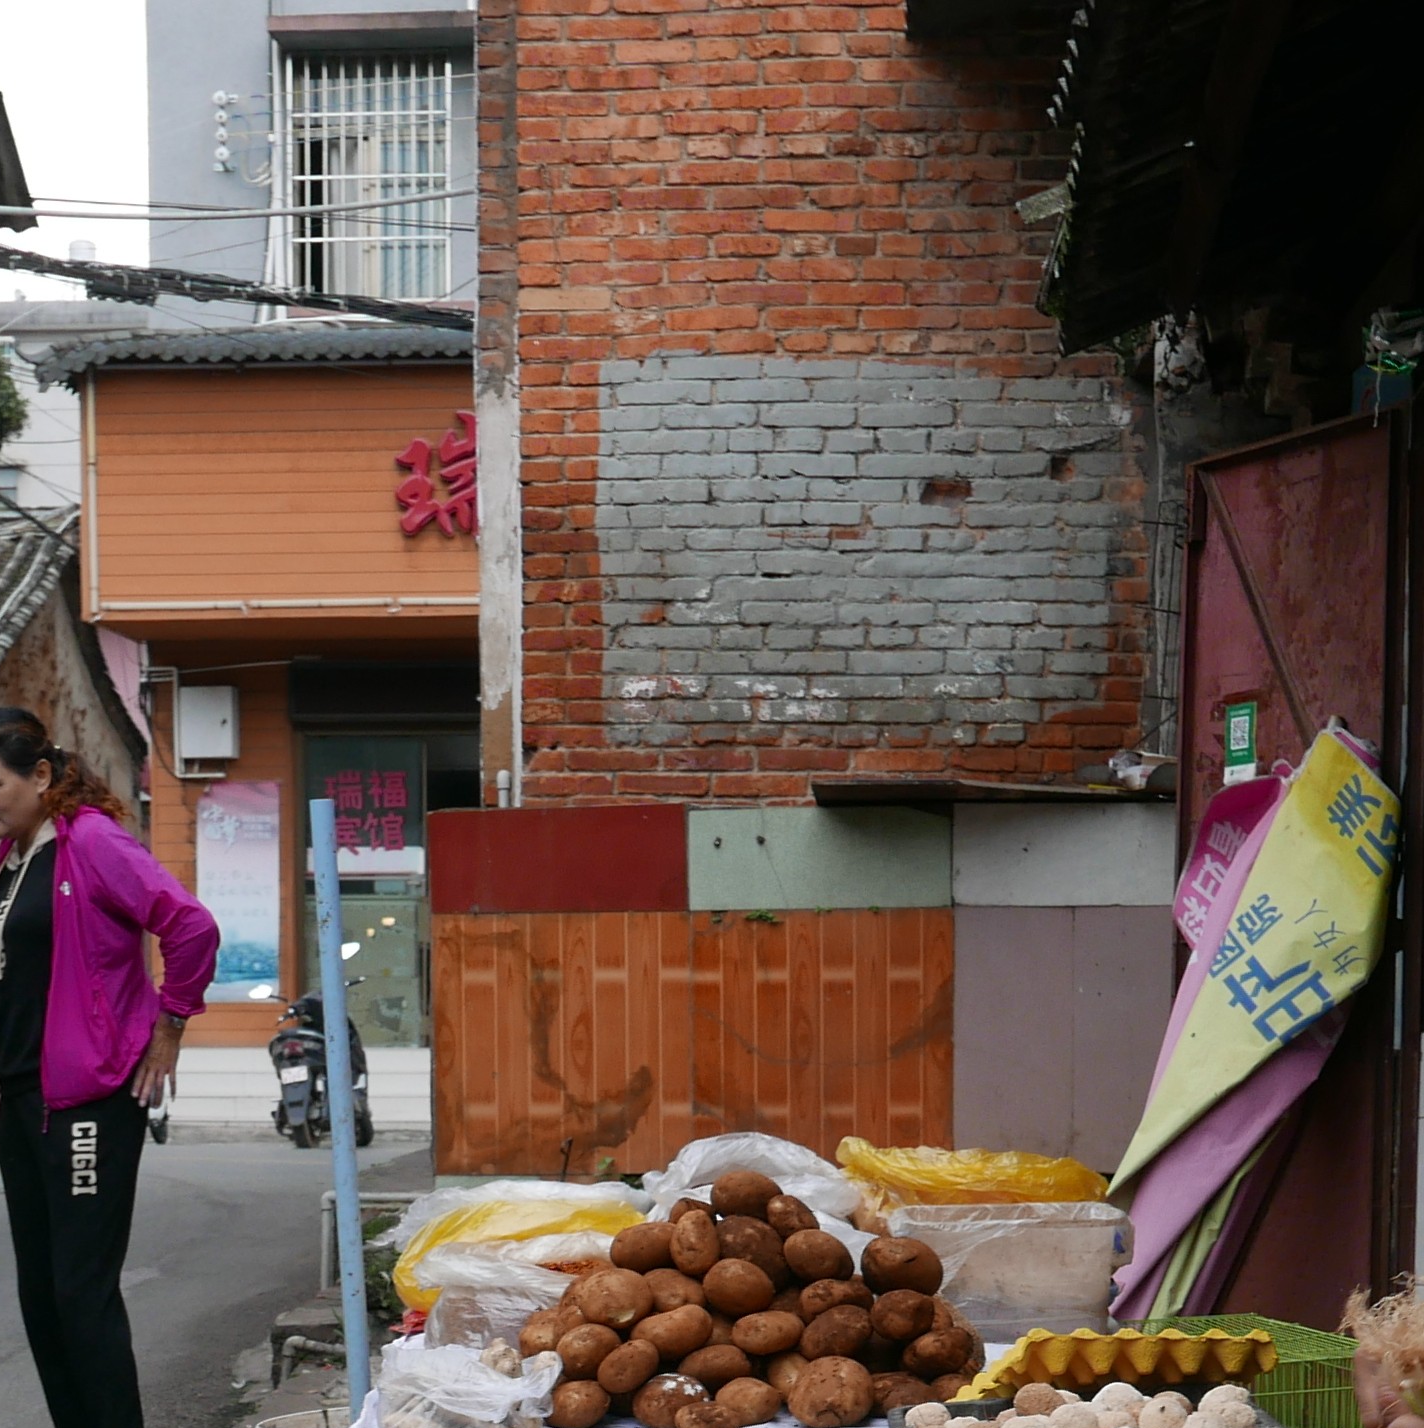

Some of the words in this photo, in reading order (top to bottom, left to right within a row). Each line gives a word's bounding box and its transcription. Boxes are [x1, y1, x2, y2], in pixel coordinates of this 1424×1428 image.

[324, 769, 409, 811] 瑞福
[334, 812, 406, 857] 宾馆
[71, 1120, 98, 1197] CUGCI
